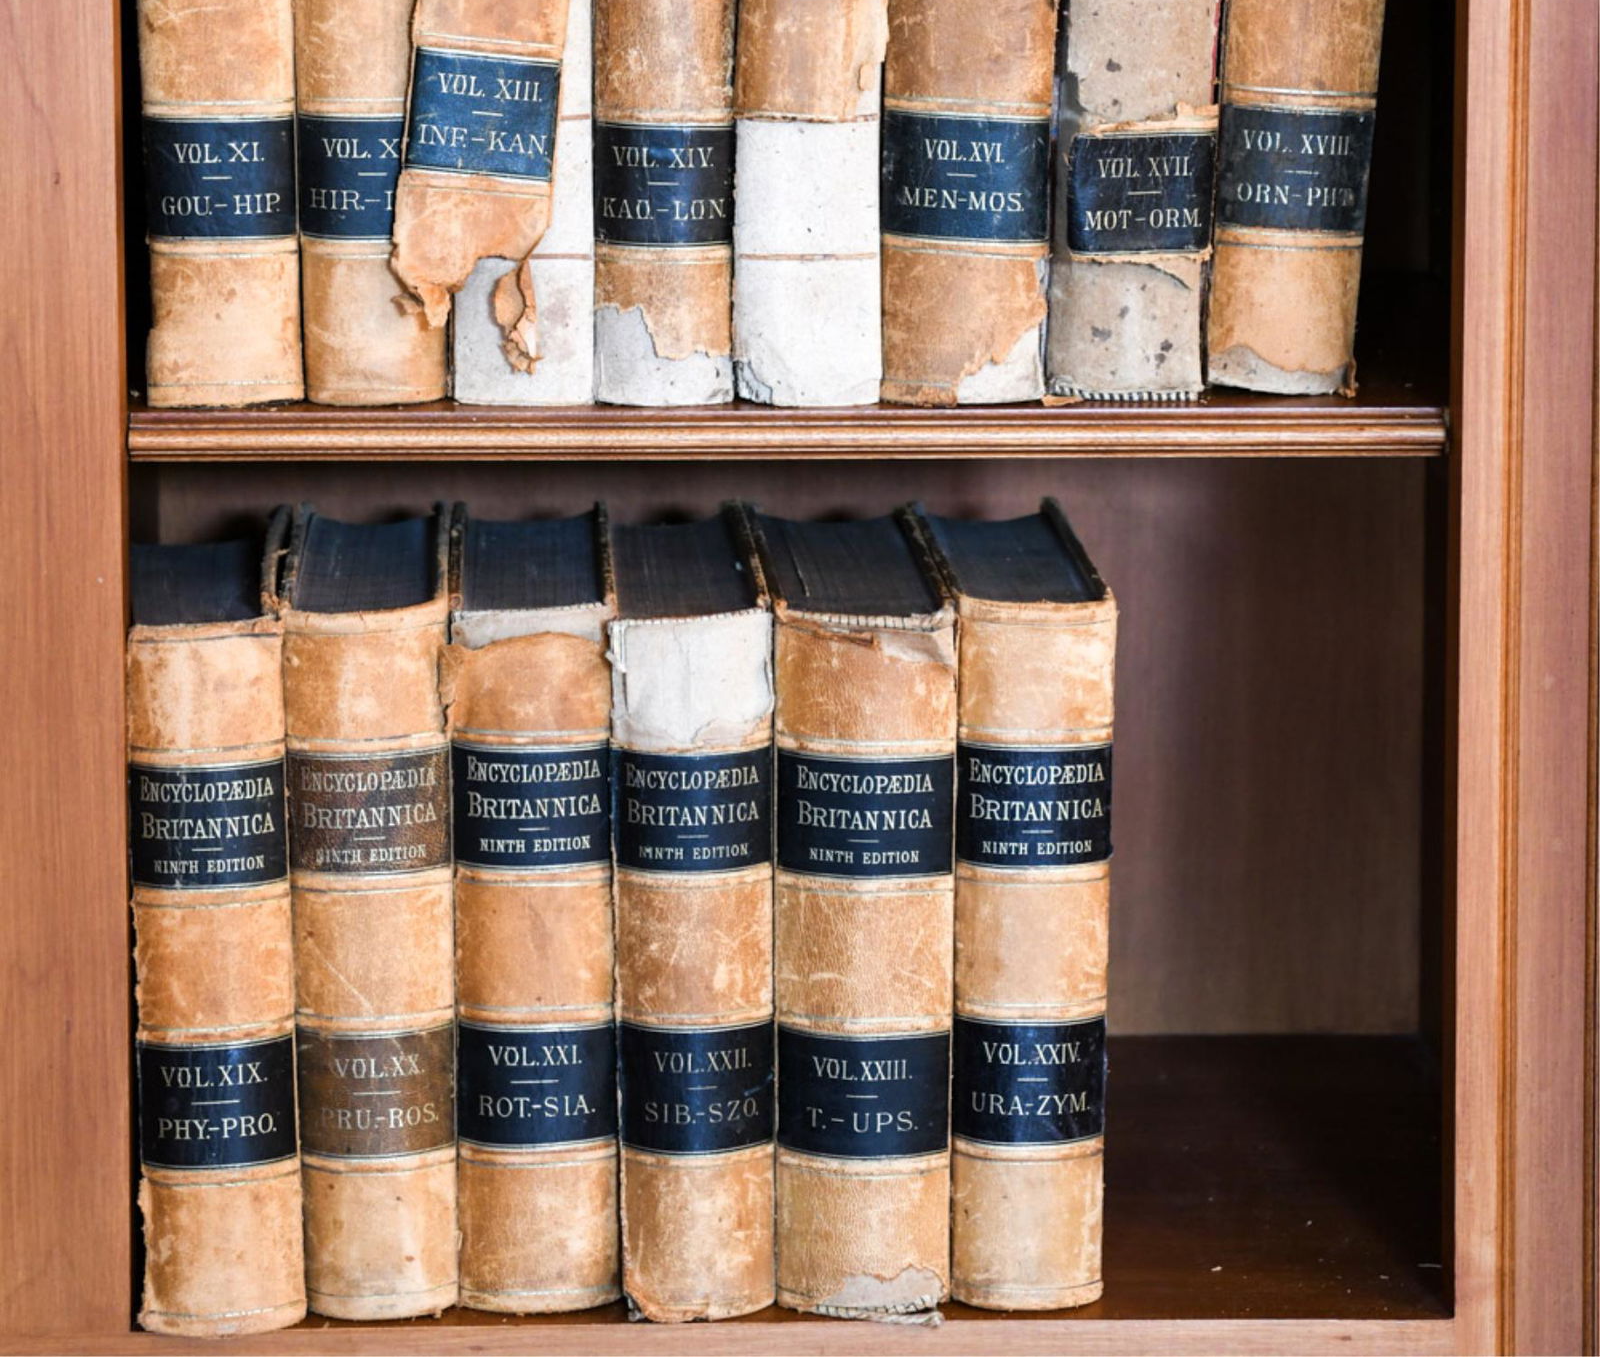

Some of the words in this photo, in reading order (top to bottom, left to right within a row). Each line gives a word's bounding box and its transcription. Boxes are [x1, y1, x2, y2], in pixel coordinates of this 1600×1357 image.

[437, 71, 486, 98] VOL.
[494, 77, 543, 103] XIII.
[174, 142, 222, 164] VOL.
[228, 142, 265, 163] XI.
[322, 137, 372, 160] VOL.
[378, 137, 400, 159] X
[612, 145, 659, 168] VOL.
[668, 146, 714, 169] XIV.
[310, 188, 393, 211] HIR.-I
[901, 186, 1025, 213] MEN-MOS.
[301, 764, 436, 794] ENCYCLOPÆDIA
[467, 755, 601, 784] ENCYCLOPÆDIA
[625, 762, 760, 791] ENCYCLOPÆDIA
[797, 764, 934, 795] ENCYCLOPÆDIA
[969, 757, 1105, 786] ENCYCLOPÆDIA
[139, 774, 274, 803] ENCYCLOPÆDIA
[303, 801, 437, 830] BRITANNICA
[467, 791, 601, 820] BRITANNICA
[627, 798, 759, 826] BRITANNICA
[797, 799, 934, 832] BRITANNICA
[969, 794, 1104, 822] BRITANNICA
[140, 811, 275, 840] BRITANNICA
[315, 848, 361, 864] NINTH
[369, 843, 427, 862] EDITION
[479, 837, 526, 853] NINTH
[533, 835, 591, 853] EDITION
[638, 844, 684, 860] NINTH
[692, 843, 749, 860] EDITION
[808, 847, 854, 864] NINTH
[862, 849, 920, 865] EDITION
[982, 840, 1028, 856] NINTH
[1036, 839, 1092, 856] EDITION
[153, 859, 199, 874] NINTH
[207, 854, 265, 874] EDITION
[478, 1094, 596, 1119] ROT.-SIA.
[971, 1091, 1090, 1117] URA.-ZYM.
[157, 1112, 277, 1140] PHY.-PRO.
